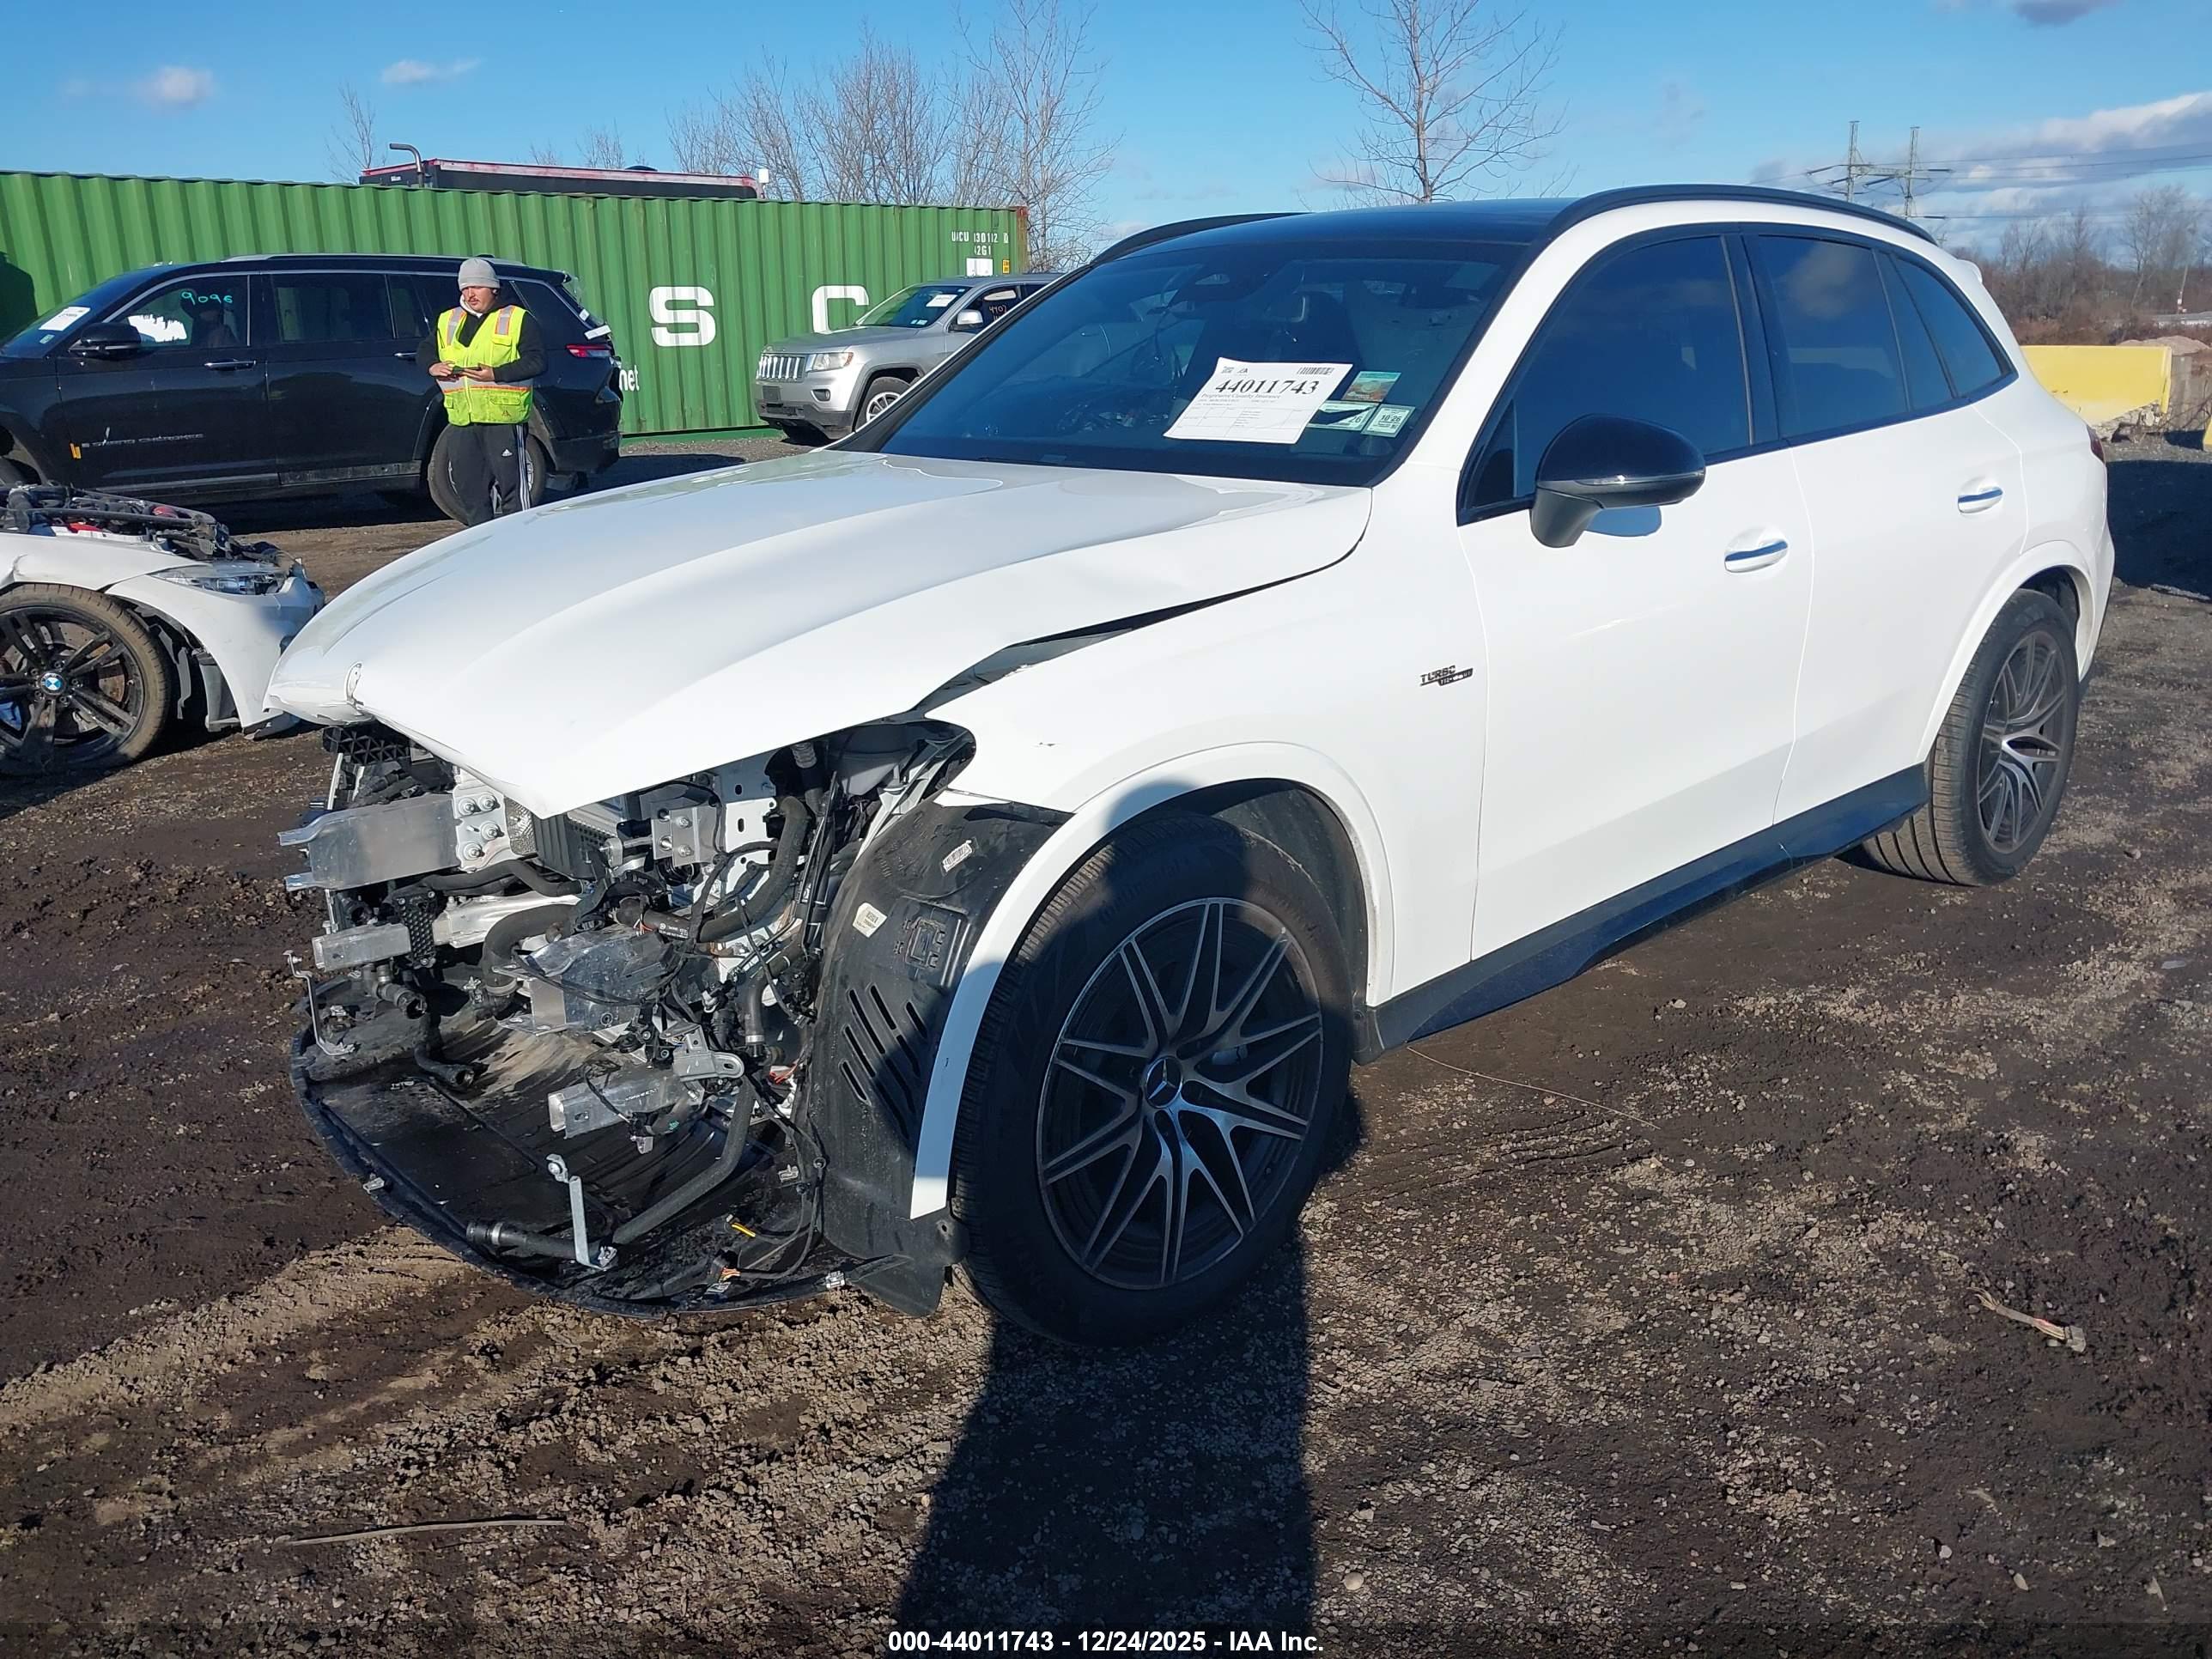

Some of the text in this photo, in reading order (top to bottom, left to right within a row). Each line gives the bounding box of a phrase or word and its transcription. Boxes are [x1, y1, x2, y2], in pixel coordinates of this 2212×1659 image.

[181, 291, 234, 306] 9096
[649, 286, 716, 347] S
[1215, 379, 1320, 395] 44011743
